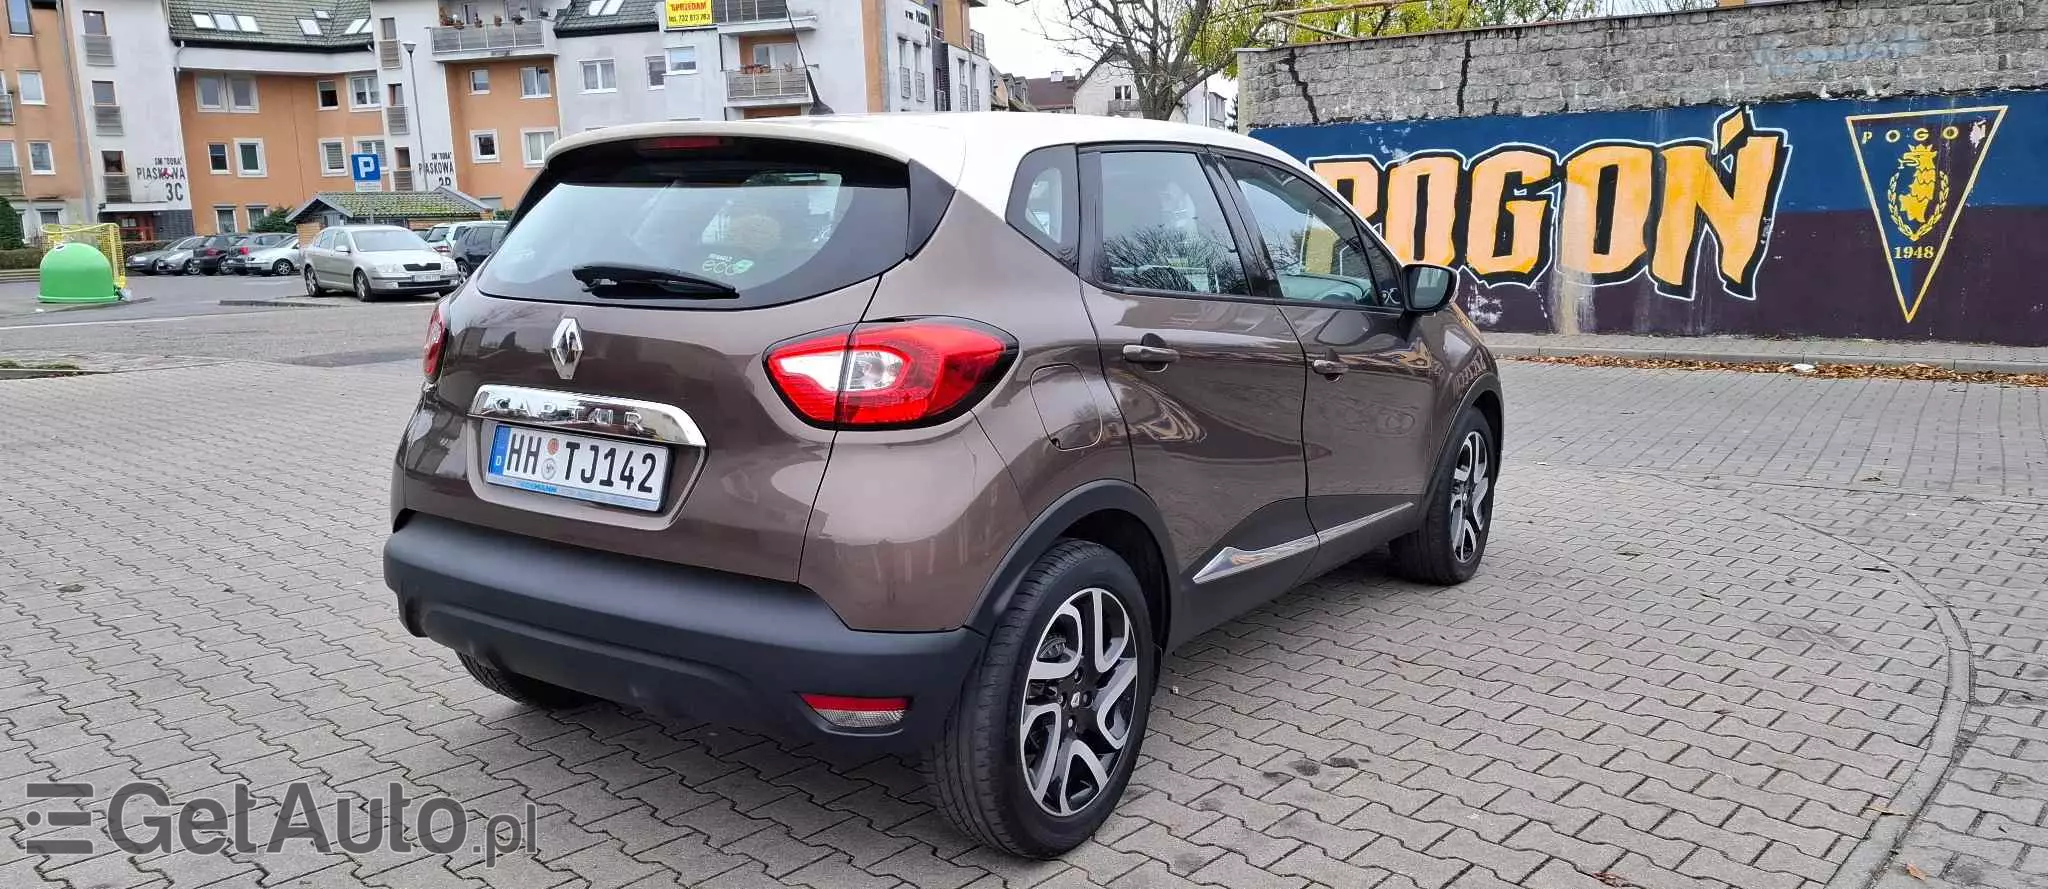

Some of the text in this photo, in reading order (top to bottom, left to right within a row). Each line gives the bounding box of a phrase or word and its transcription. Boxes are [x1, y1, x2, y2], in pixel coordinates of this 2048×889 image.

[358, 156, 376, 178] P
[418, 161, 454, 176] PASKOWA
[165, 182, 184, 201] 3C
[1303, 106, 1792, 300] POGOŃ
[1894, 246, 1935, 260] 1948
[496, 398, 644, 433] CAPTUR
[506, 433, 542, 475] HH
